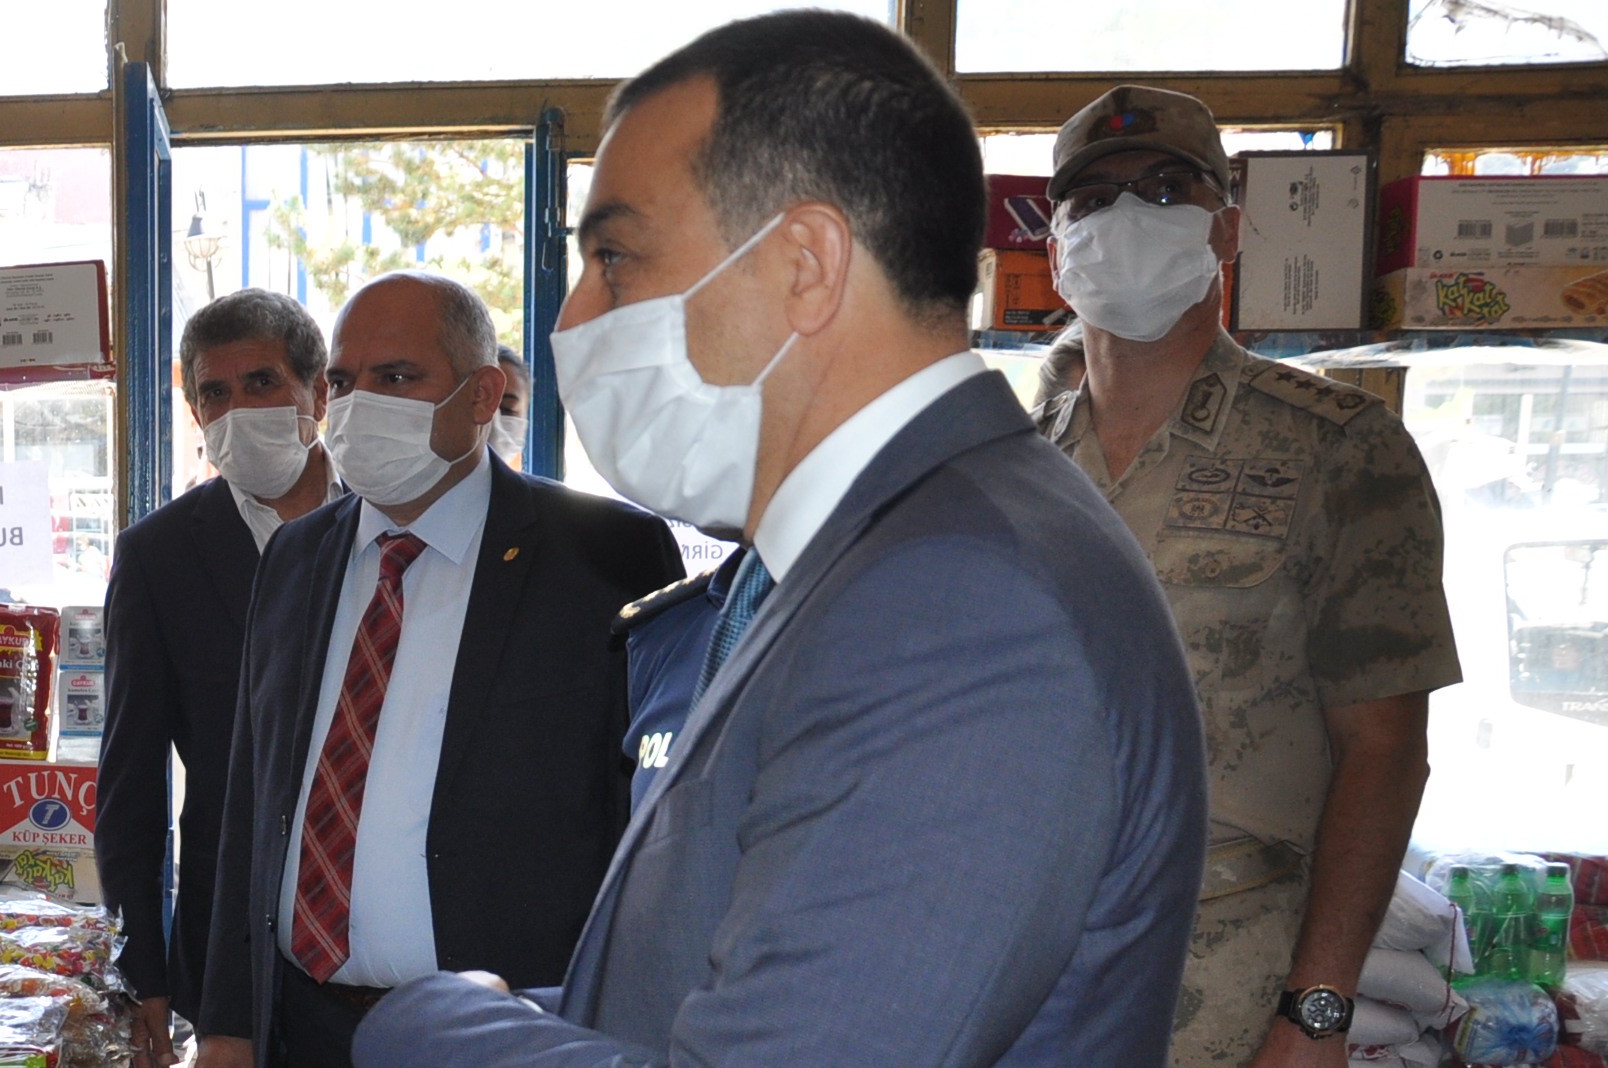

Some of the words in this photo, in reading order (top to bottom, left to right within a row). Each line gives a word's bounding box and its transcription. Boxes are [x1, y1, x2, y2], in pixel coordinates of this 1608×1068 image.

[2, 770, 97, 816] TUNÇ
[41, 803, 60, 825] T
[12, 829, 40, 843] KÜP
[41, 832, 87, 846] ŞEKER
